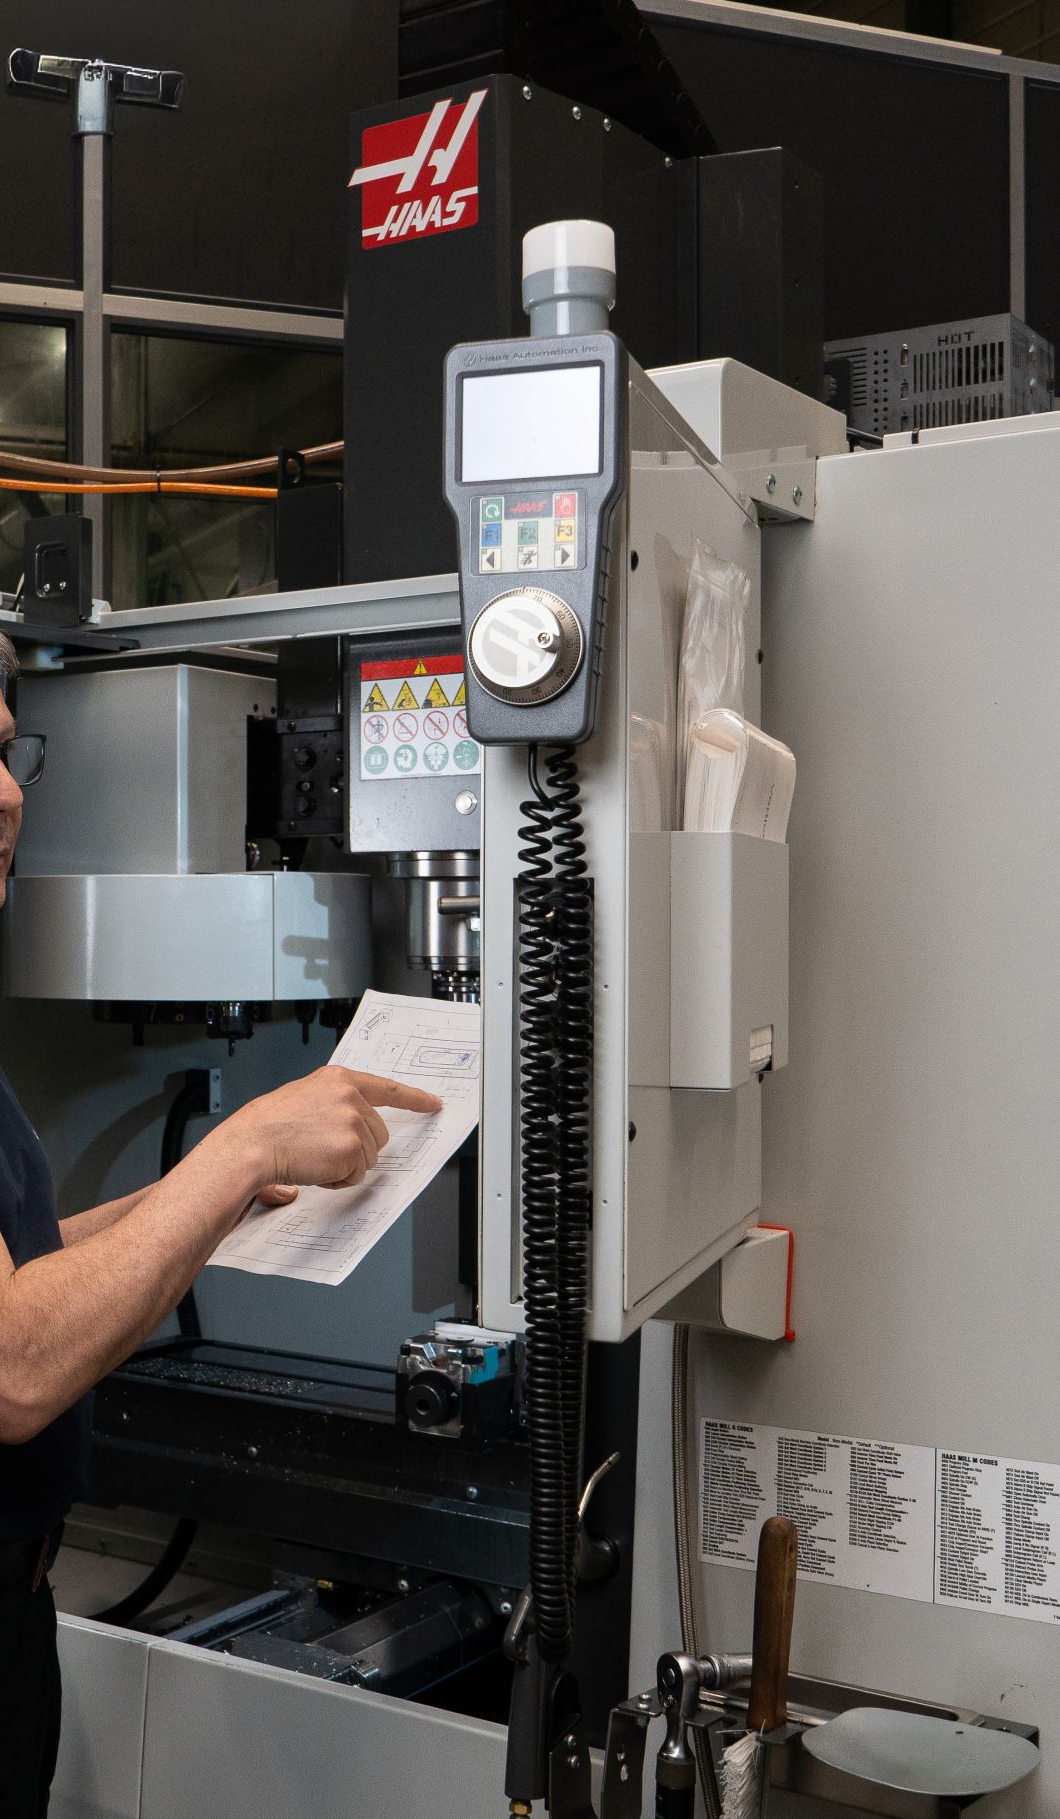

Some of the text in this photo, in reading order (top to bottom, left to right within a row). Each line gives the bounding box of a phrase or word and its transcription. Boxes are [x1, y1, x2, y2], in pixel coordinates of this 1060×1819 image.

[362, 186, 478, 242] HAAS
[938, 330, 974, 346] HOT
[512, 348, 578, 360] Automation
[485, 526, 573, 541] F1 F2 F3
[979, 1458, 998, 1466] CODES
